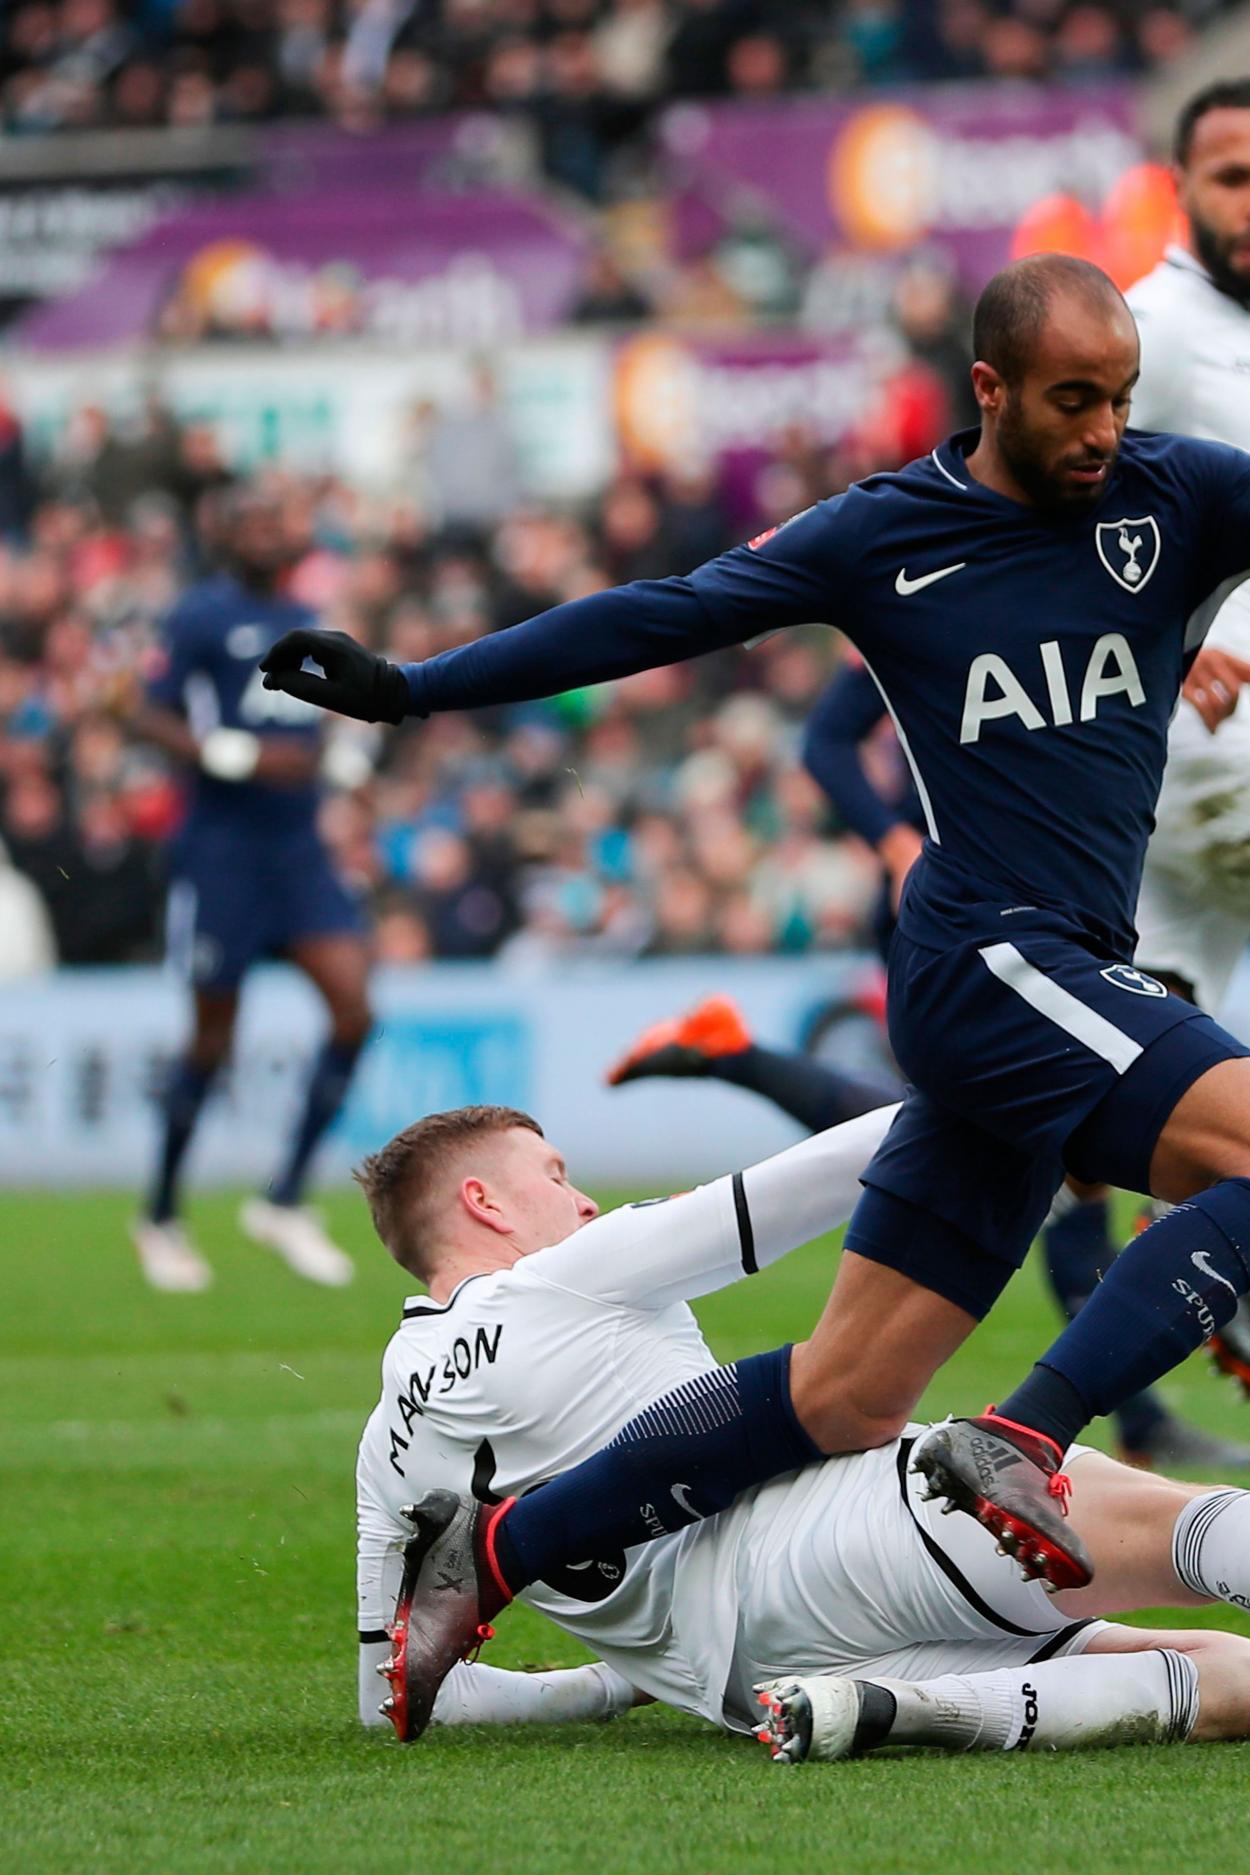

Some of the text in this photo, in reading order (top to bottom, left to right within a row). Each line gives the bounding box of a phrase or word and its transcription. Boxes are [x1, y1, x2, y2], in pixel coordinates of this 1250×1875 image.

[959, 632, 1147, 745] AIA
[640, 1503, 668, 1537] SPU
[1016, 1682, 1038, 1751] JOM
